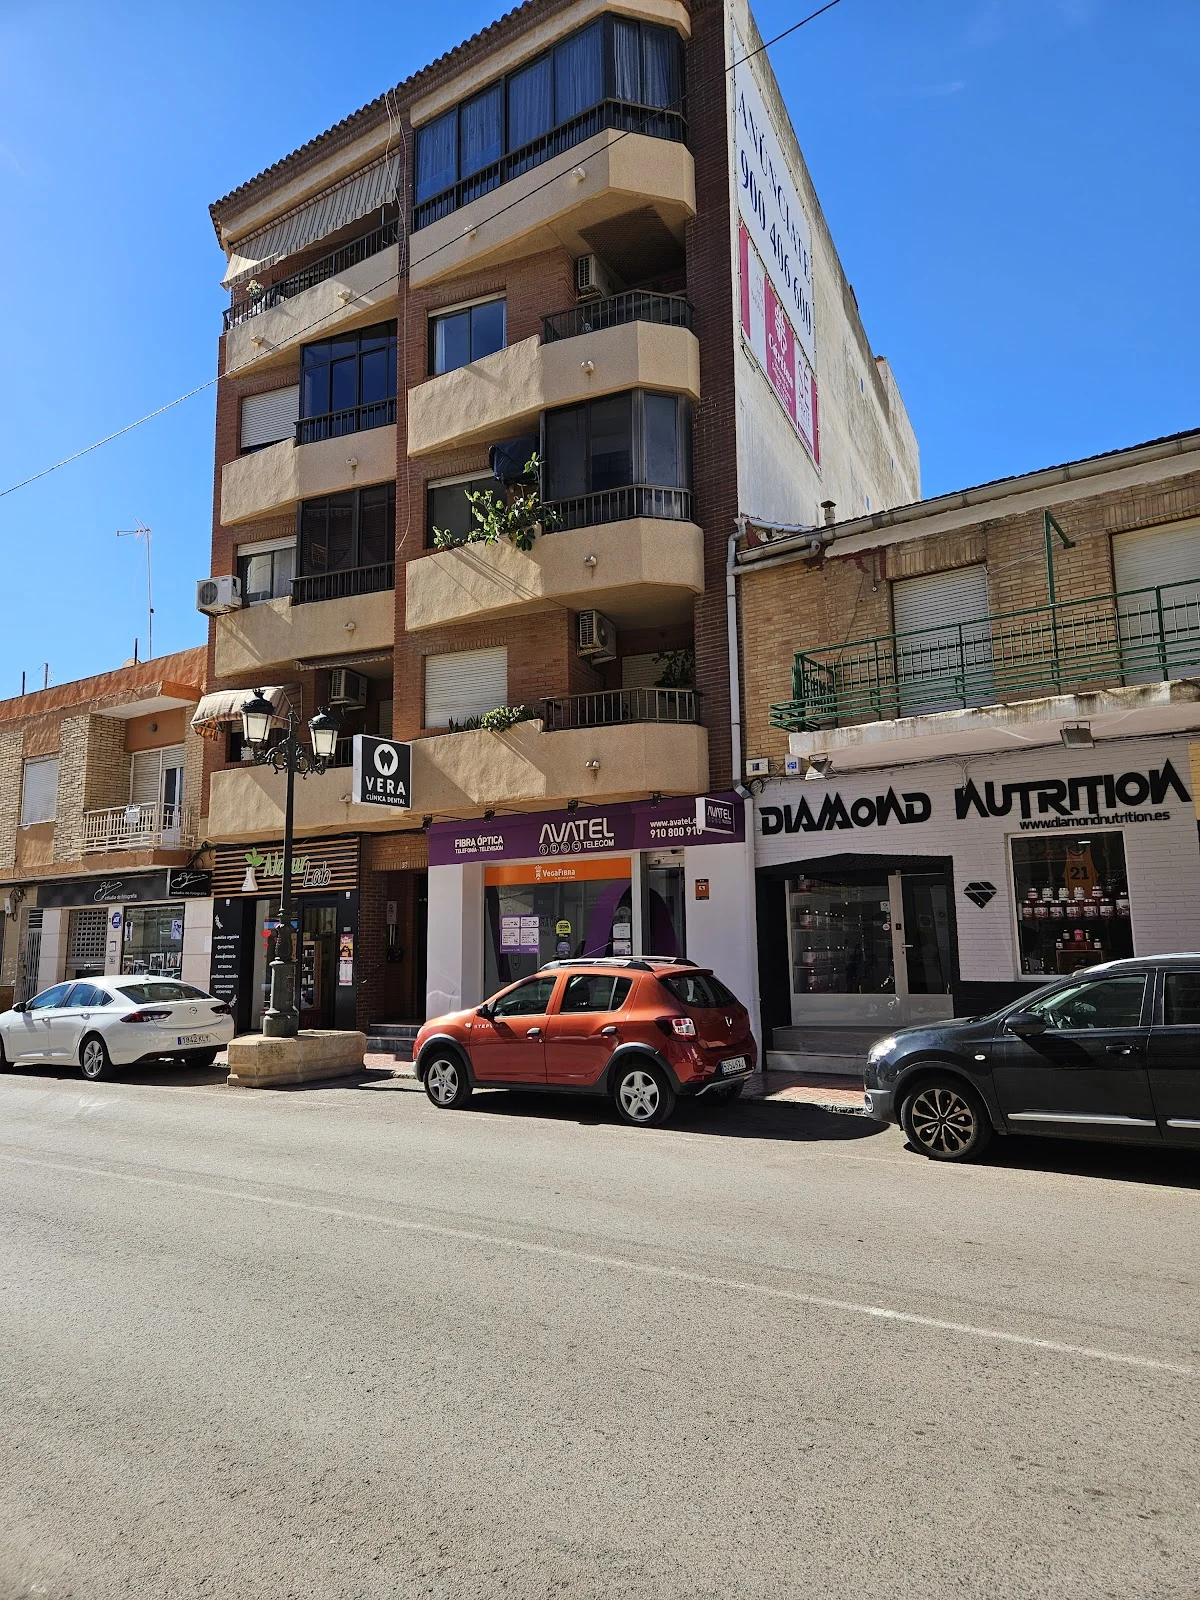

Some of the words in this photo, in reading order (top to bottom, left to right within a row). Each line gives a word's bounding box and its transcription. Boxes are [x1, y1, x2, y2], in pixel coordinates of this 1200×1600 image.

[738, 90, 811, 286] ANÚNCIATE
[740, 149, 766, 230] 900
[769, 222, 791, 288] 406
[793, 276, 811, 335] 600
[366, 776, 406, 795] VERA
[366, 793, 386, 802] CLÍNICA
[759, 786, 931, 835] DIAMOND
[955, 758, 1192, 819] NUTRITION
[707, 805, 732, 820] AVATEL
[1019, 809, 1171, 830] www.diamondnutrition.es
[538, 817, 615, 844] AVATEL
[649, 817, 697, 828] www.avatel.e
[454, 837, 475, 848] FIBRA
[476, 834, 504, 846] ÓPTICA
[649, 829, 667, 839] 910
[667, 827, 685, 837] 800
[582, 838, 615, 849] TELECOM
[262, 851, 309, 878] Naur
[302, 860, 332, 888] Lab
[1069, 866, 1090, 880] 21
